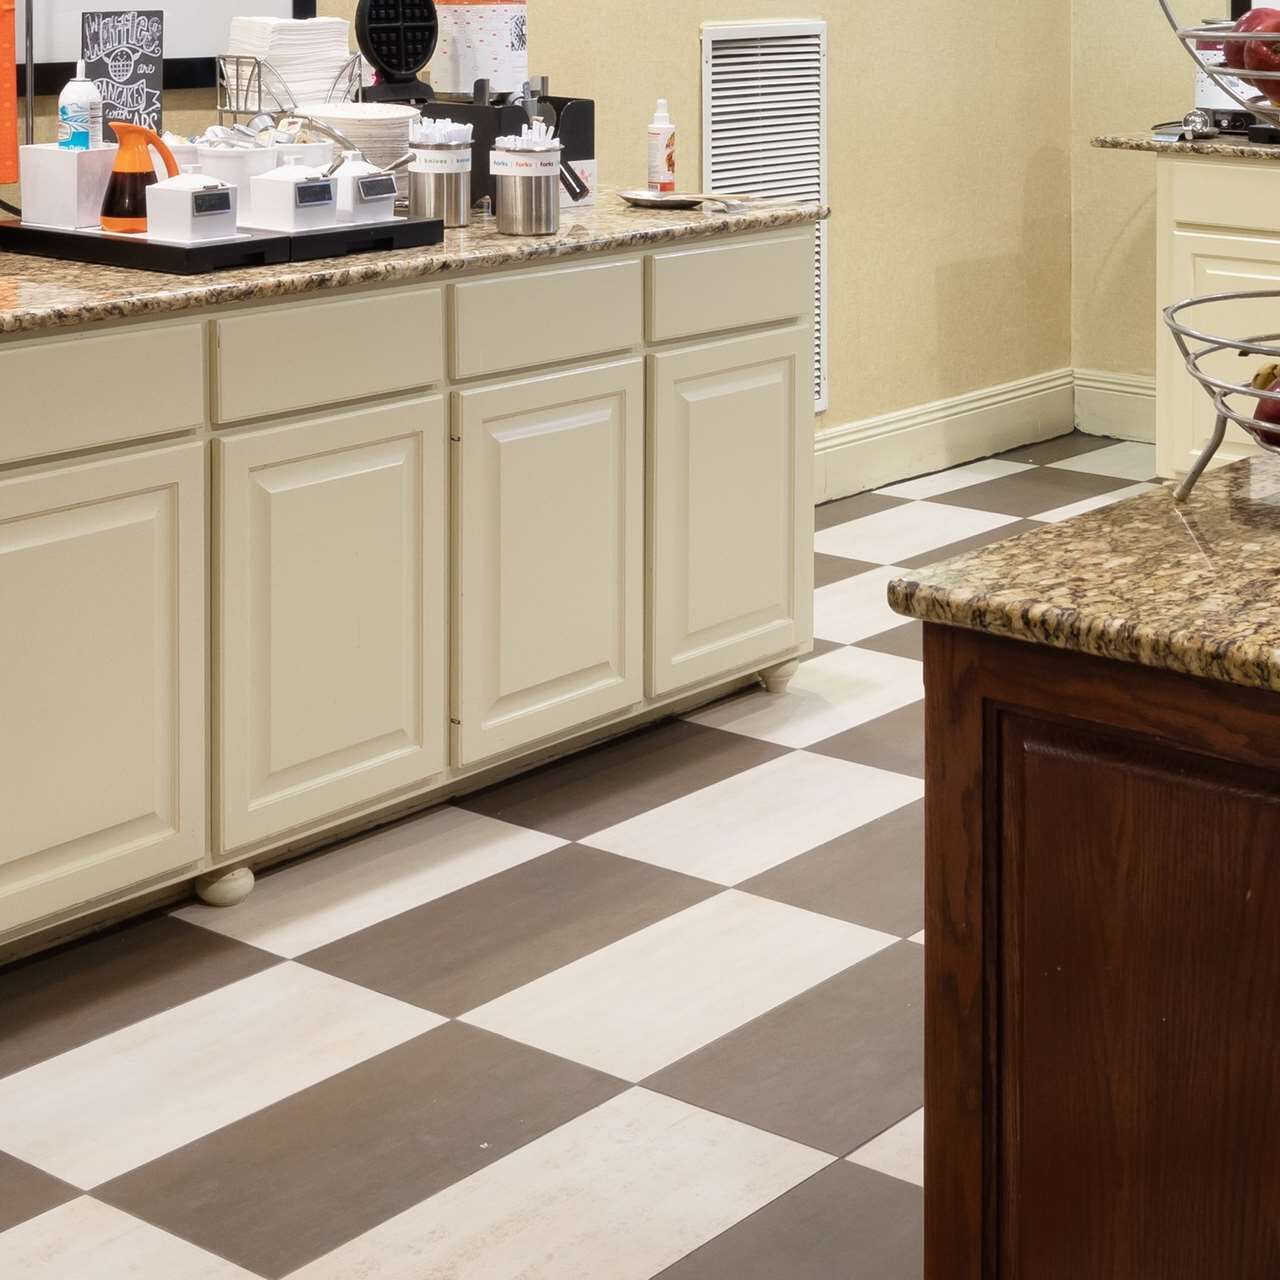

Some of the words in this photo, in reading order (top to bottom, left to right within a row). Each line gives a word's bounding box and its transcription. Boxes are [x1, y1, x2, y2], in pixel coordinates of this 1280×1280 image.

[85, 12, 161, 60] Waffles
[137, 64, 155, 74] are
[96, 81, 146, 109] PANCAKES
[106, 108, 132, 120] with
